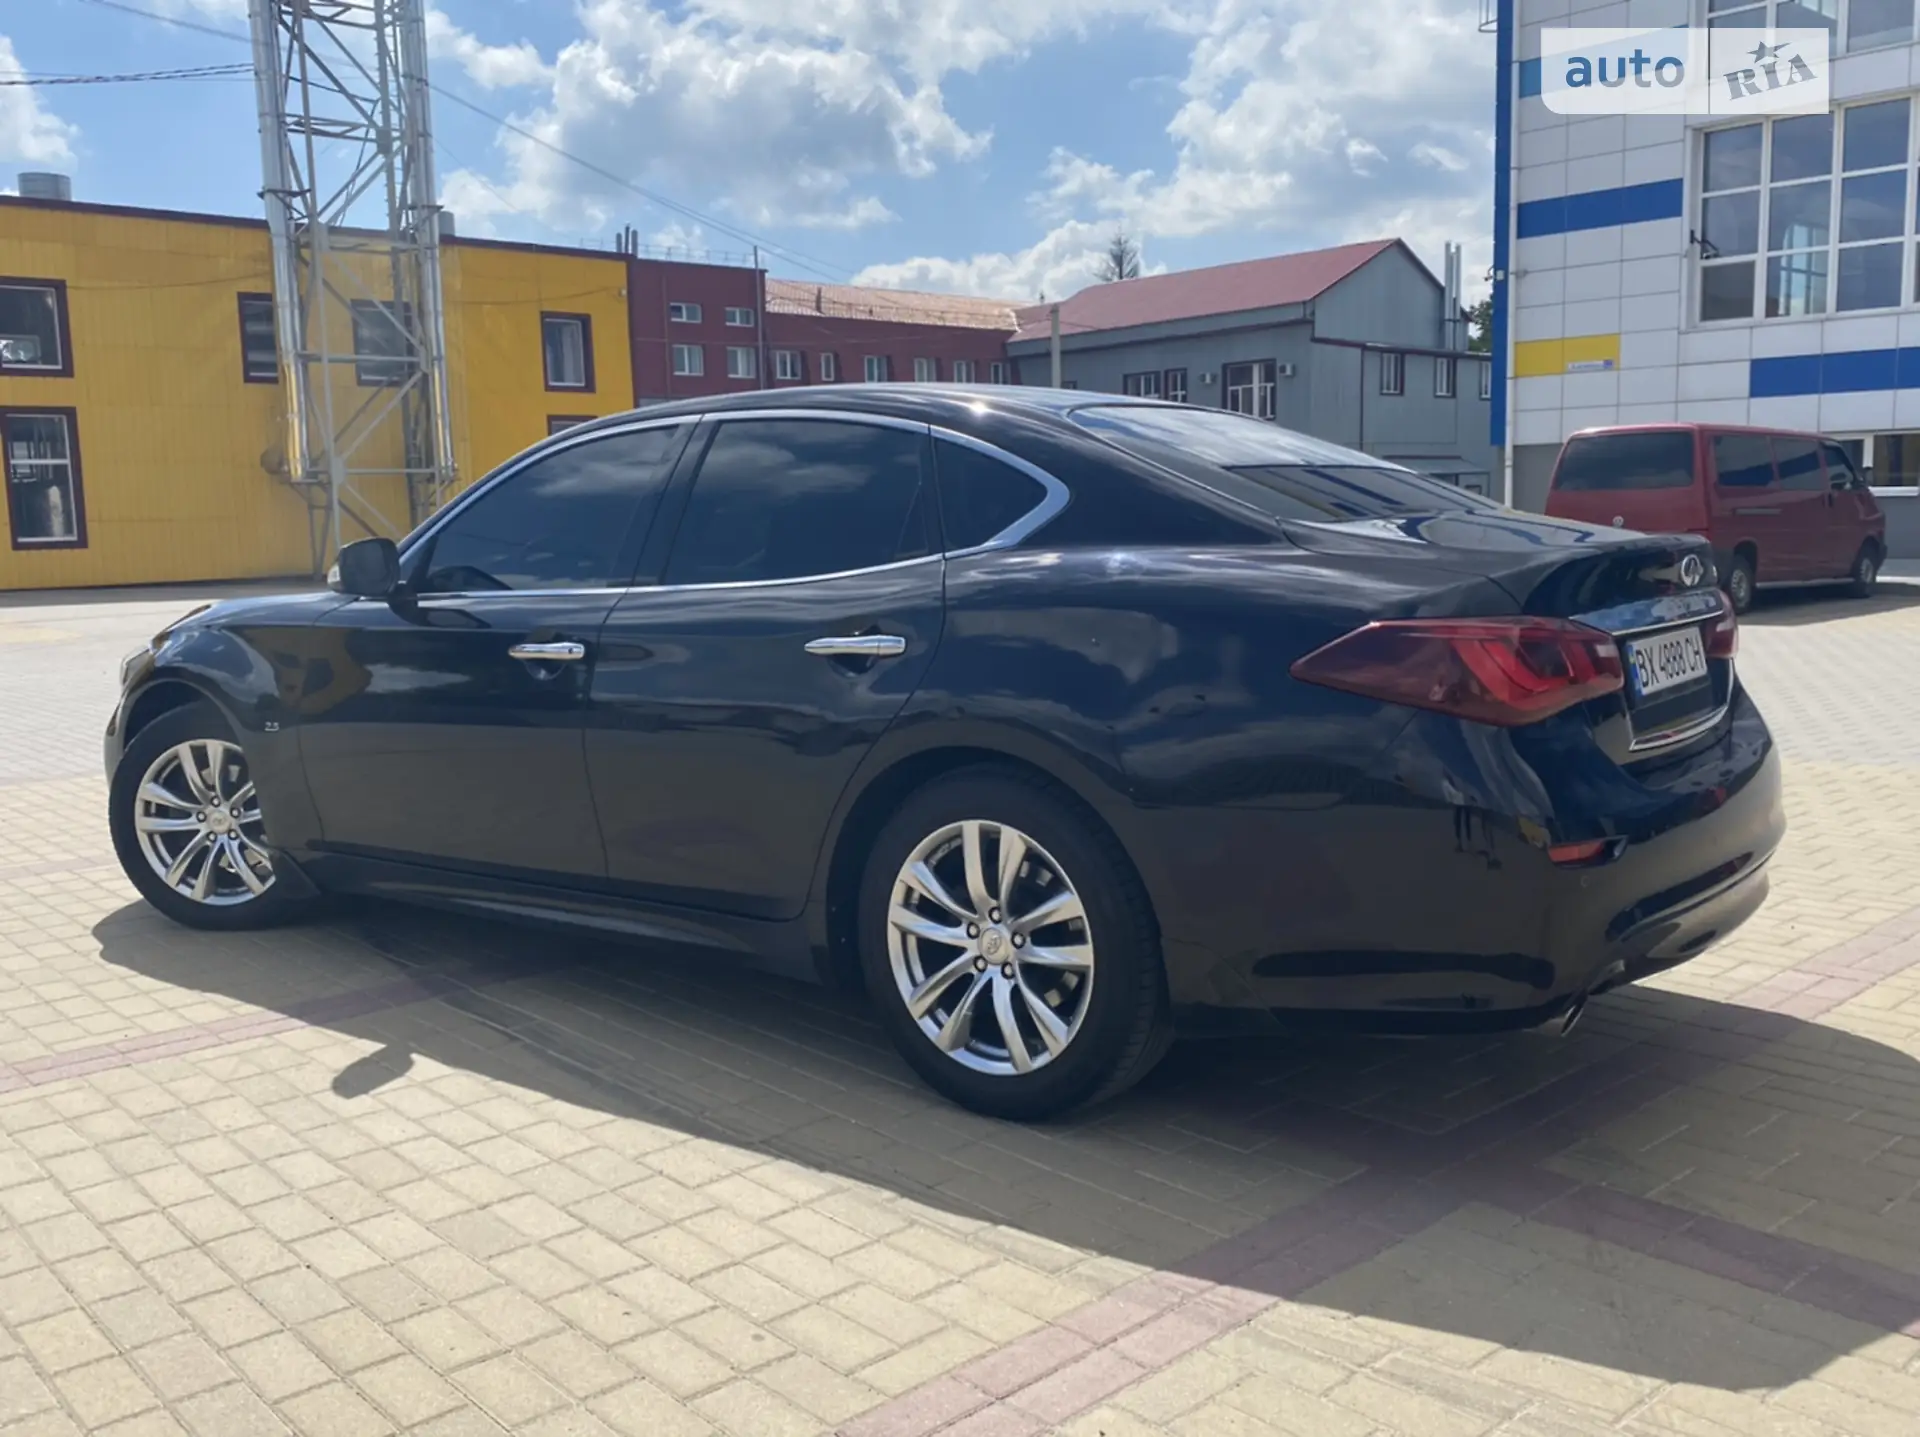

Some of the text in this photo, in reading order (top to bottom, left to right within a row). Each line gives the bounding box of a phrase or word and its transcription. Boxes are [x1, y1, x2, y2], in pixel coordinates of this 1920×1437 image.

[1635, 634, 1704, 688] BX 4888 CH
